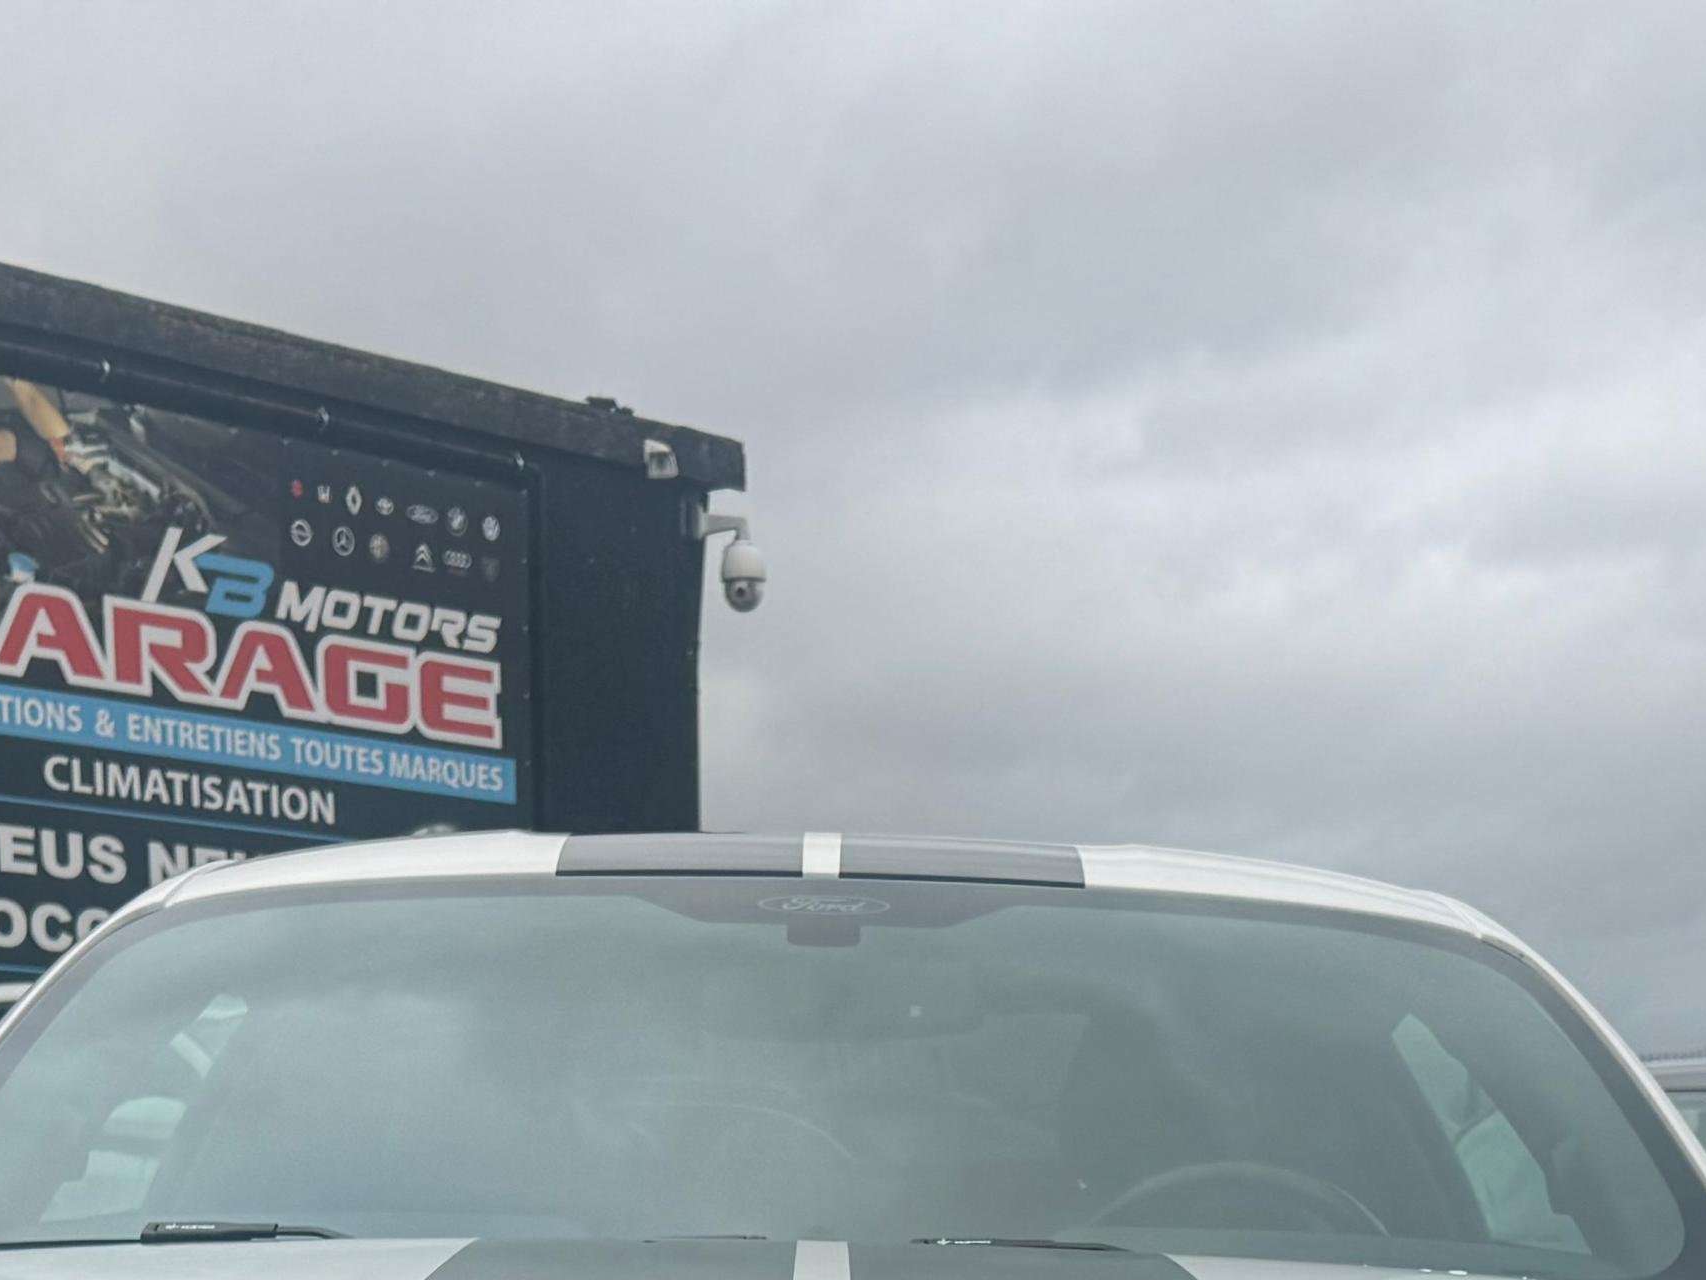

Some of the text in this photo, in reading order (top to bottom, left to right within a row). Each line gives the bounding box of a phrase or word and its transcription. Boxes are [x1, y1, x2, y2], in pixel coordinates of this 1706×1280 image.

[142, 526, 502, 655] KB MOTORS
[43, 755, 336, 826] CLIMATISATION
[94, 709, 118, 738] &
[127, 712, 282, 762] ENTRETIENS
[290, 735, 384, 776] TOUTES
[389, 751, 504, 792] MARQUES
